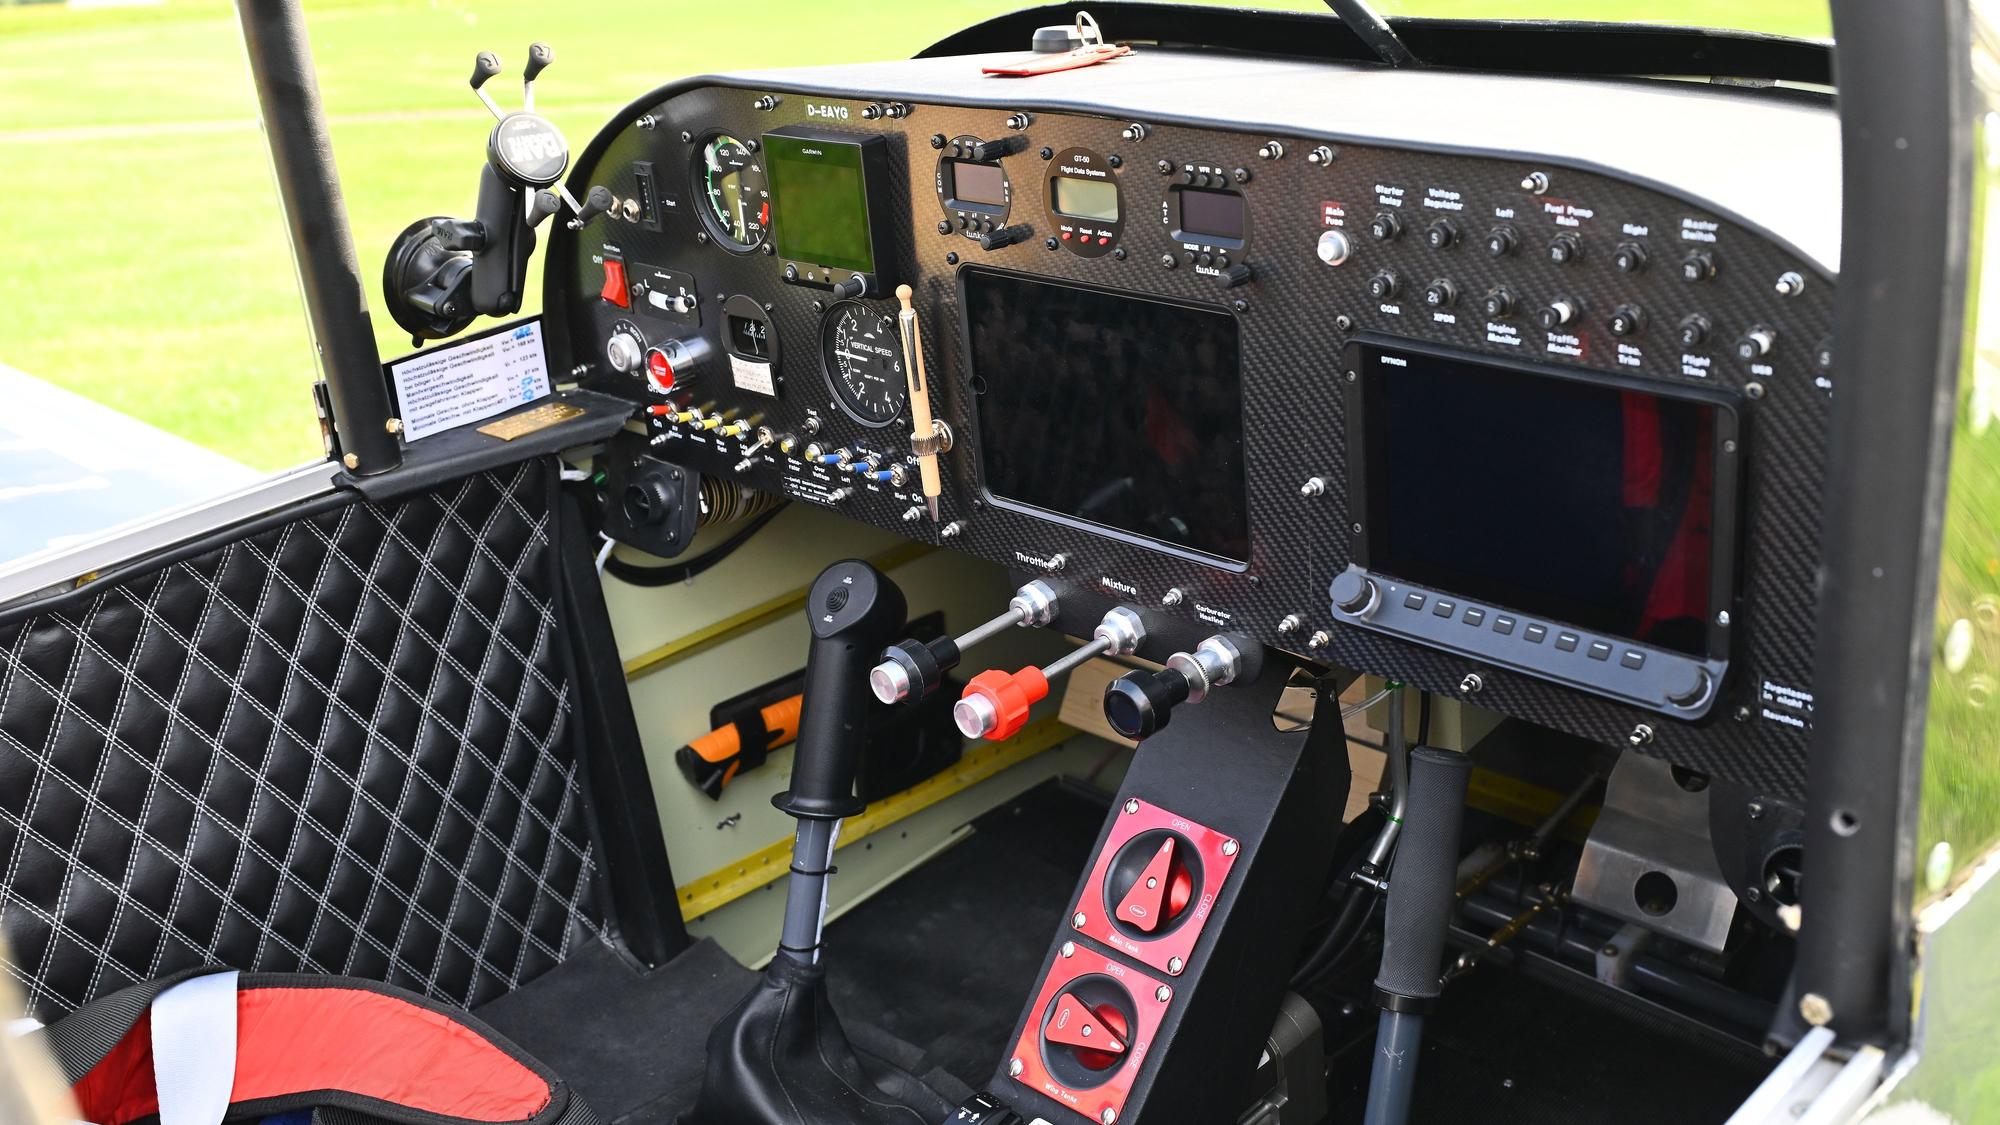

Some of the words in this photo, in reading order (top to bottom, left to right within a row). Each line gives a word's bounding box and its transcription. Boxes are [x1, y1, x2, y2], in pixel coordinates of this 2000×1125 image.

[807, 104, 848, 119] D-EAYG
[736, 148, 746, 156] 140
[1074, 155, 1090, 163] GT-50
[1061, 166, 1074, 174] Flight
[1074, 167, 1085, 175] Data
[1086, 168, 1106, 177] Systems
[1375, 185, 1404, 196] Starter
[1429, 188, 1460, 200] Voltage
[1380, 195, 1402, 207] Relay
[1424, 197, 1463, 210] Regulator
[1326, 207, 1345, 217] Main
[1496, 208, 1514, 219] Left
[1545, 203, 1564, 214] Fuel
[1567, 205, 1594, 219] Pump
[1326, 217, 1344, 227] Fuse
[1556, 215, 1579, 227] Main
[1080, 227, 1092, 235] Reset
[1097, 230, 1113, 238] Action
[1431, 232, 1438, 244] 5
[1490, 240, 1499, 250] 4
[1618, 256, 1627, 268] 4
[1196, 265, 1220, 276] funke
[644, 279, 650, 288] L
[1373, 283, 1380, 294] 5
[680, 287, 687, 297] R
[1380, 304, 1400, 315] COM
[1487, 301, 1495, 312] 5
[851, 319, 858, 332] 2
[877, 322, 883, 334] 4
[1614, 319, 1623, 332] 2
[1547, 332, 1579, 346] Traffic
[1683, 330, 1693, 343] 2
[851, 341, 874, 353] VERTICAL
[874, 346, 892, 358] SPEED
[1381, 356, 1407, 367] DYNON
[1618, 354, 1641, 367] Trim
[893, 361, 900, 373] 6
[859, 381, 865, 394] 2
[885, 391, 891, 403] 4
[807, 408, 817, 416] Test
[653, 419, 662, 428] On
[907, 456, 920, 466] Off
[912, 493, 923, 503] On
[1015, 551, 1050, 569] Throttle
[1102, 576, 1137, 595] Mixture
[1195, 604, 1231, 620] Carburetor
[1199, 614, 1224, 626] Heating
[1763, 681, 1813, 702] Zugelasse
[1171, 819, 1191, 832] OPEN
[1196, 893, 1212, 920] CLOSE
[1109, 935, 1123, 945] Main
[1125, 942, 1139, 953] Tank
[1106, 963, 1126, 977] OPEN
[1129, 1042, 1146, 1070] CLOSE
[1045, 1083, 1060, 1095] Wing
[1060, 1090, 1078, 1103] Tanks
